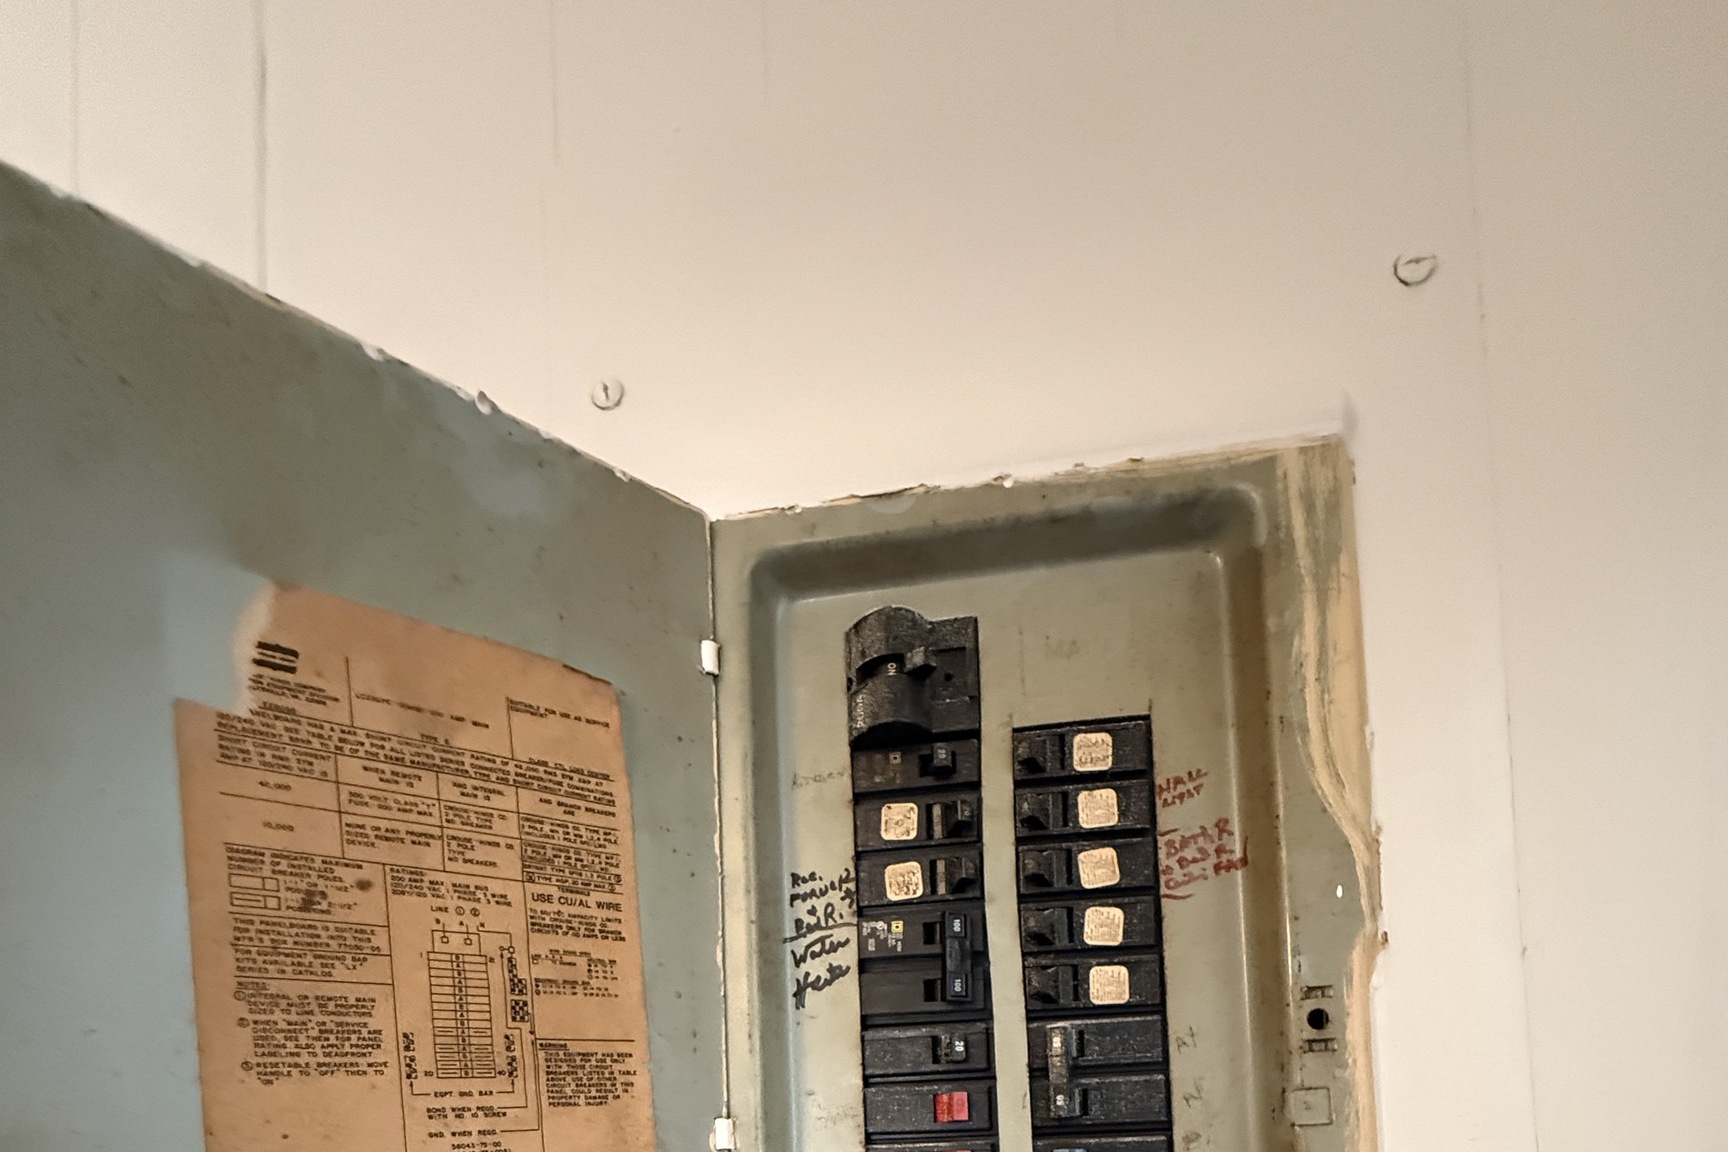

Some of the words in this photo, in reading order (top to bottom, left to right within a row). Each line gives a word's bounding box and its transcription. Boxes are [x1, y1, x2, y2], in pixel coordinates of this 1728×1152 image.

[532, 892, 554, 904] USE
[558, 895, 591, 909] CU/AL
[596, 901, 623, 912] WIRE
[952, 919, 961, 932] 100
[954, 978, 962, 992] 100
[954, 1041, 965, 1052] 20
